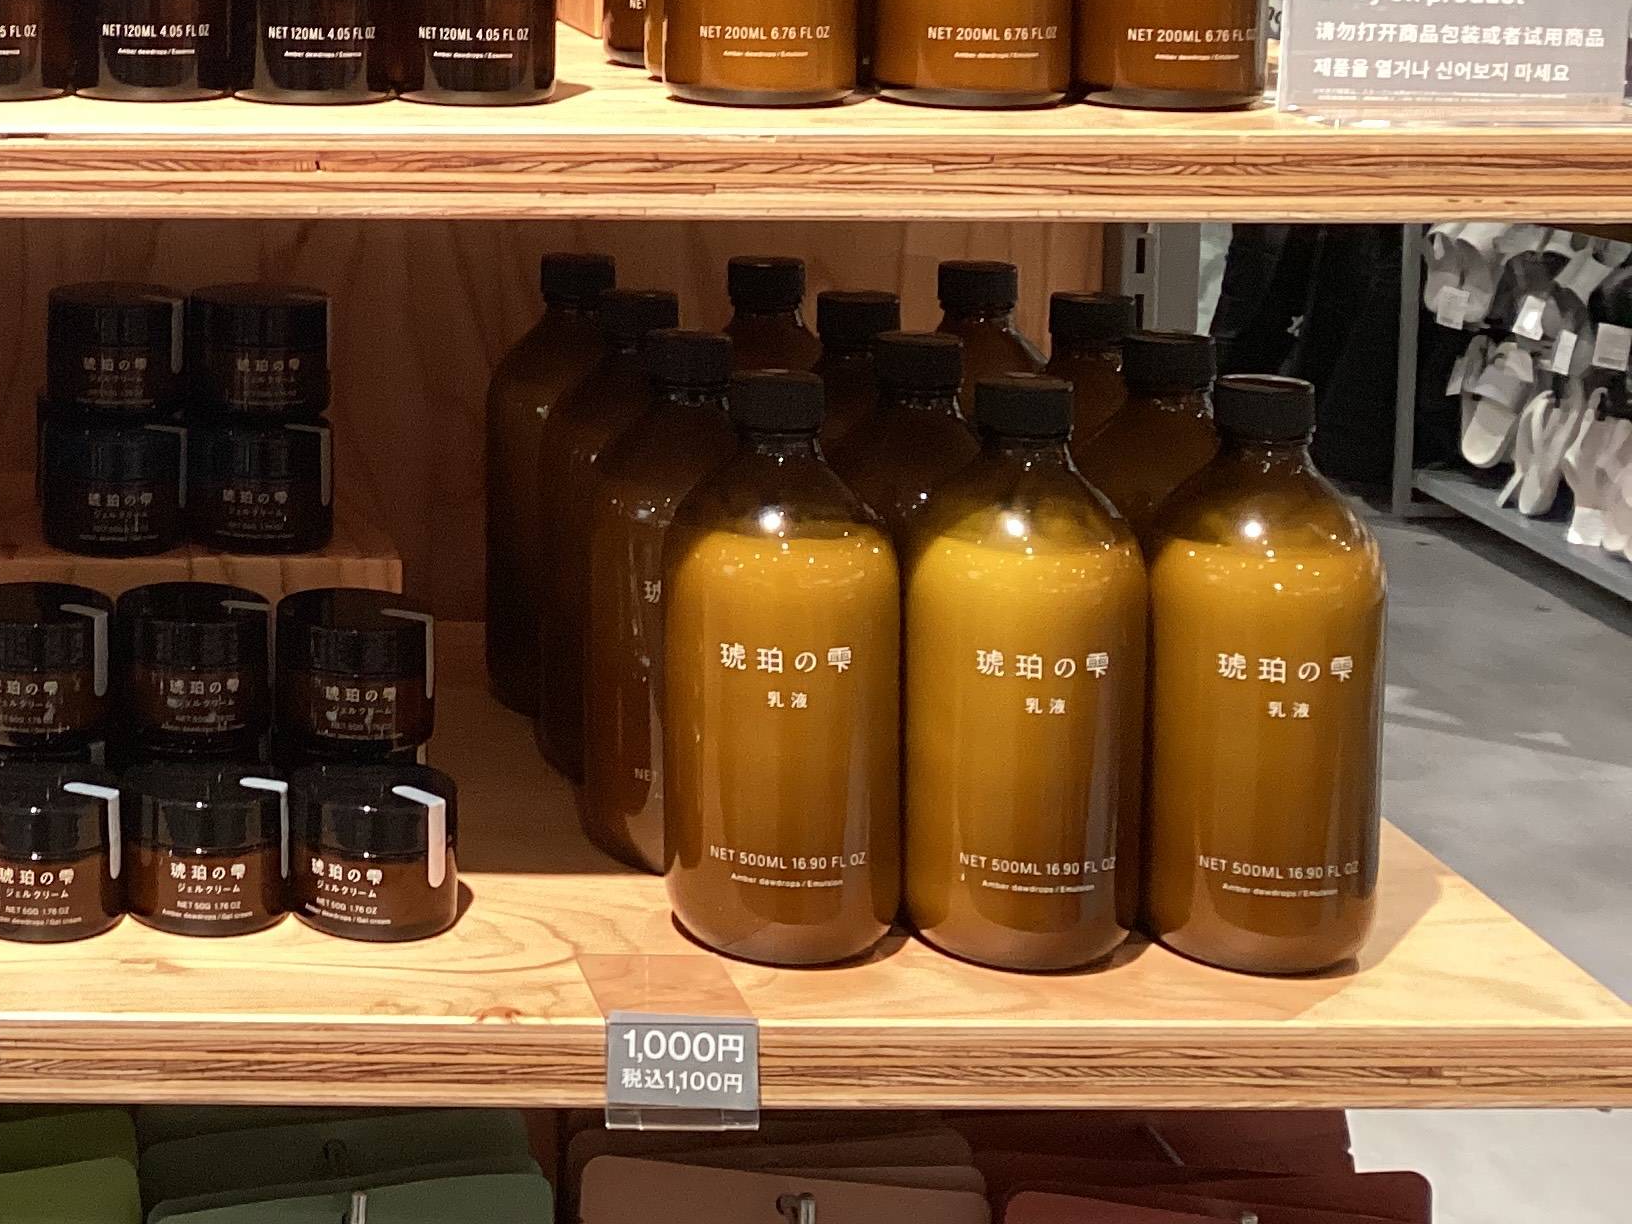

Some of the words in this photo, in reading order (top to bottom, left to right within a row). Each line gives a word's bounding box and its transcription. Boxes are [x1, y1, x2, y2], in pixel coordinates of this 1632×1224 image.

[10, 25, 21, 37] FL
[24, 25, 36, 37] OZ
[418, 26, 436, 40] NET
[439, 27, 472, 41] 120ML
[503, 29, 514, 40] FL
[517, 28, 528, 40] OZ
[700, 26, 721, 38] NET
[725, 26, 767, 39] 200ML
[800, 27, 813, 39] FL
[816, 26, 830, 38] OZ
[1315, 22, 1604, 47] 请勿打开商品包装或者试用商品
[1313, 57, 1368, 78] 제품을
[1375, 59, 1430, 79] 열거나
[1436, 61, 1508, 81] 신어보지
[1514, 63, 1569, 82] 마세요
[720, 643, 851, 673] 琥珀の雫
[976, 650, 1108, 680] 琥珀の雫
[1218, 653, 1352, 683] 琥珀の雫
[768, 691, 807, 708] 乳液
[1025, 698, 1065, 714] 乳液
[1268, 702, 1309, 717] 乳液
[710, 845, 735, 861] NET
[739, 851, 788, 869] 500ML
[832, 856, 846, 867] FL
[850, 852, 865, 865] OZ
[959, 851, 987, 868] NET
[992, 859, 1042, 875] 500ML
[1084, 861, 1098, 873] FL
[1102, 856, 1115, 870] OZ
[1197, 855, 1227, 871] NET
[1232, 862, 1283, 879] 500ML
[1328, 865, 1341, 877] FL
[1344, 861, 1358, 874] OZ
[0, 867, 74, 886] 琥珀の雫
[171, 862, 245, 880] 琥珀の雫
[312, 857, 382, 883] 琥珀の雫
[7, 889, 68, 899] ジェルクリーム
[178, 883, 240, 894] ジェルクリーム
[317, 881, 377, 899] ジェルクリーム
[623, 1026, 744, 1063] 1,000円
[622, 1068, 742, 1094] 税込1,100円
